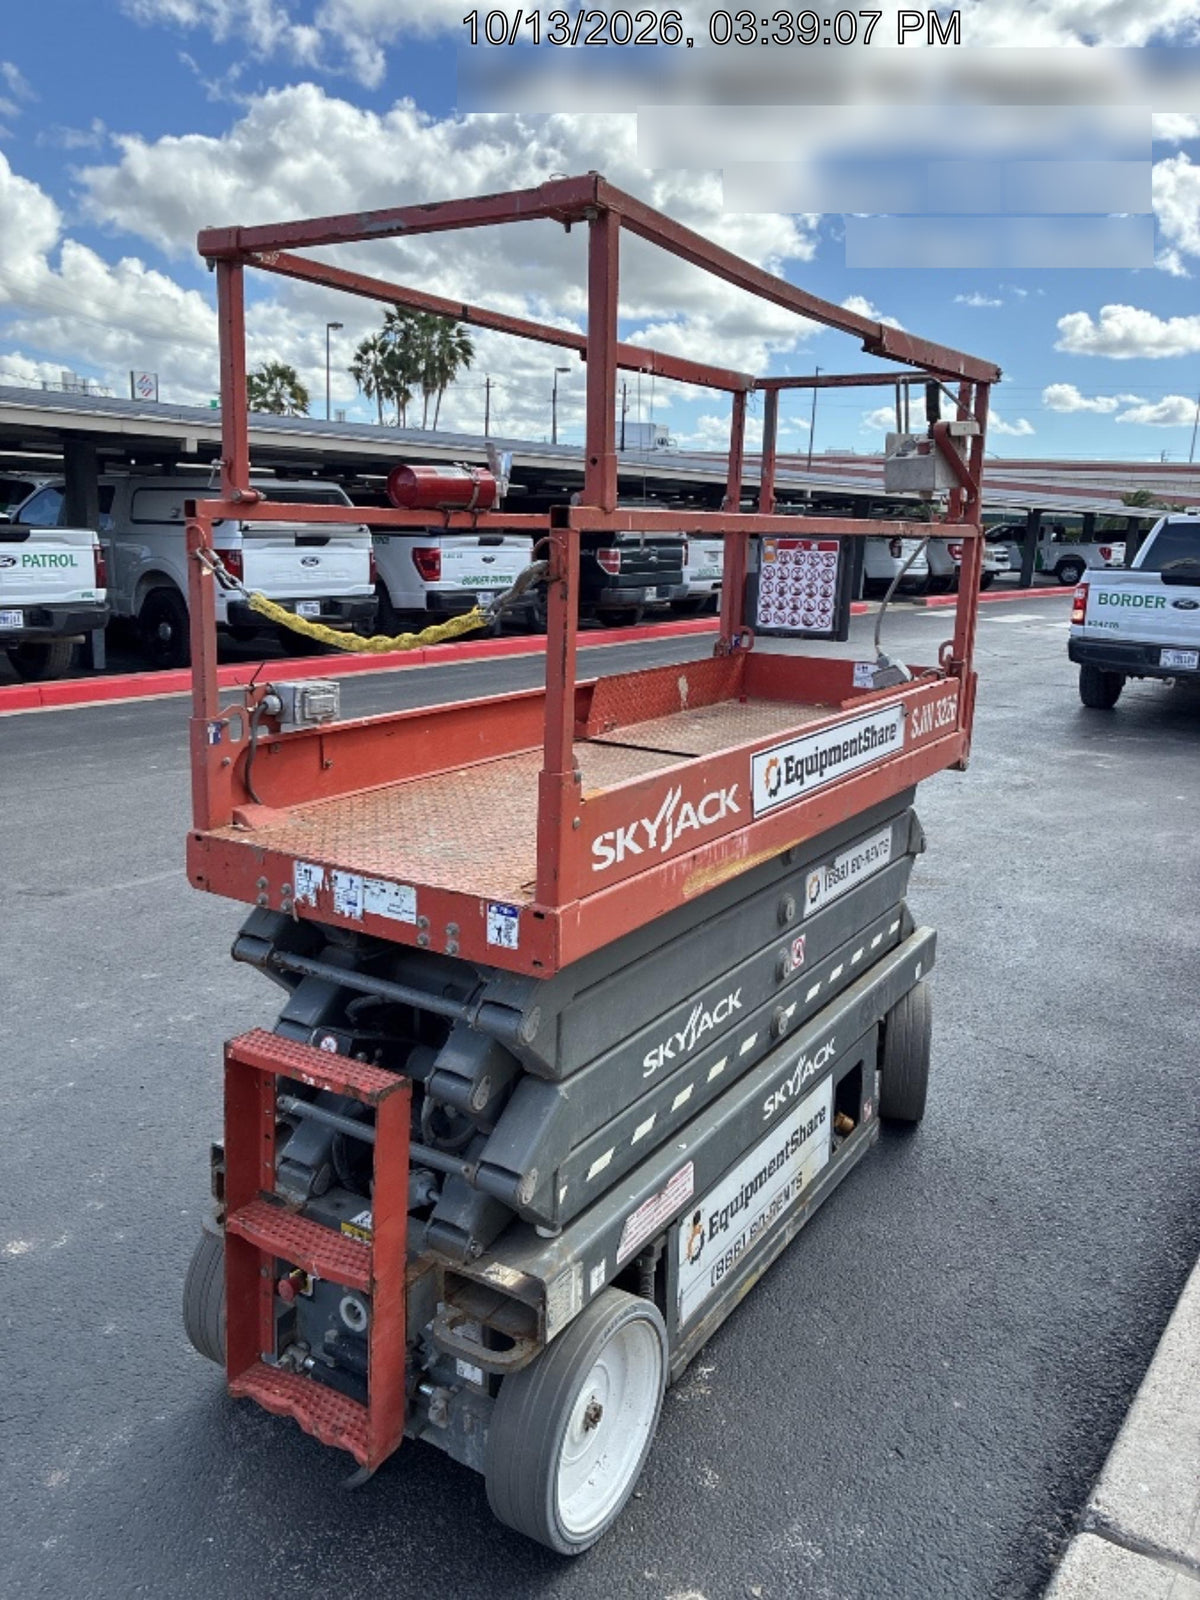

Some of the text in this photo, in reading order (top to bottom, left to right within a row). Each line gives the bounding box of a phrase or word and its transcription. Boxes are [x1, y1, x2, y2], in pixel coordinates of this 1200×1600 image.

[22, 554, 78, 568] PATROL
[1098, 593, 1167, 609] BORDER
[784, 723, 897, 785] EquipmentShare
[591, 784, 741, 871] SKYJACK
[643, 987, 742, 1078] SKYJACK
[763, 1036, 836, 1120] SKYJACK
[708, 1106, 826, 1241] EquipmentShare
